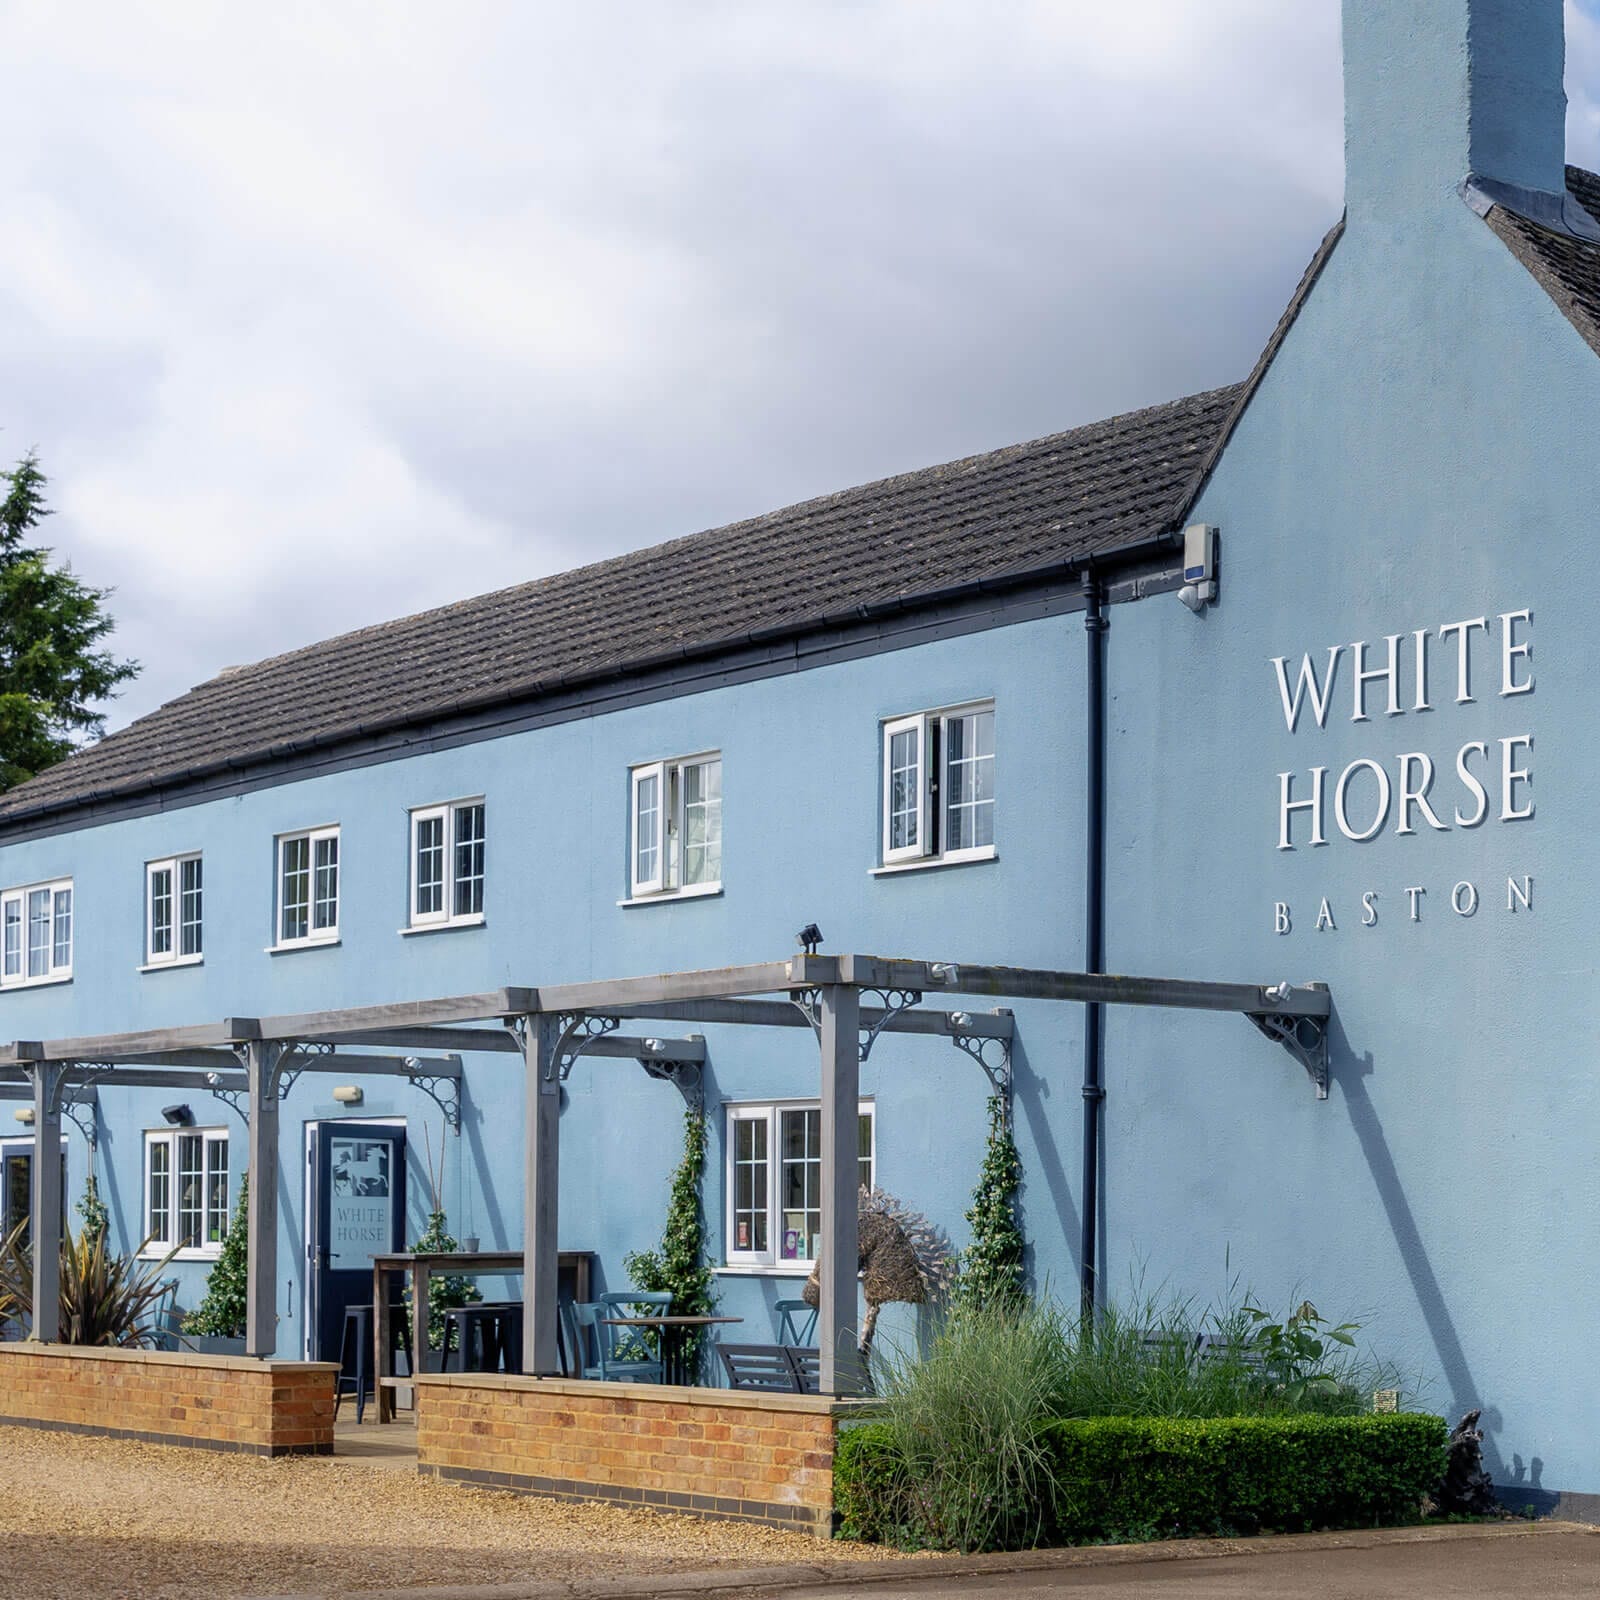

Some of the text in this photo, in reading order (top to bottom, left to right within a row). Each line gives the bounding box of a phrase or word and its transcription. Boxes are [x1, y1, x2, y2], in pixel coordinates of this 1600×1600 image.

[1270, 608, 1534, 733] WHITE
[1276, 734, 1534, 850] HORSE
[1273, 875, 1533, 934] BASTON
[337, 1208, 384, 1223] WHITE
[337, 1226, 384, 1241] HORSE
